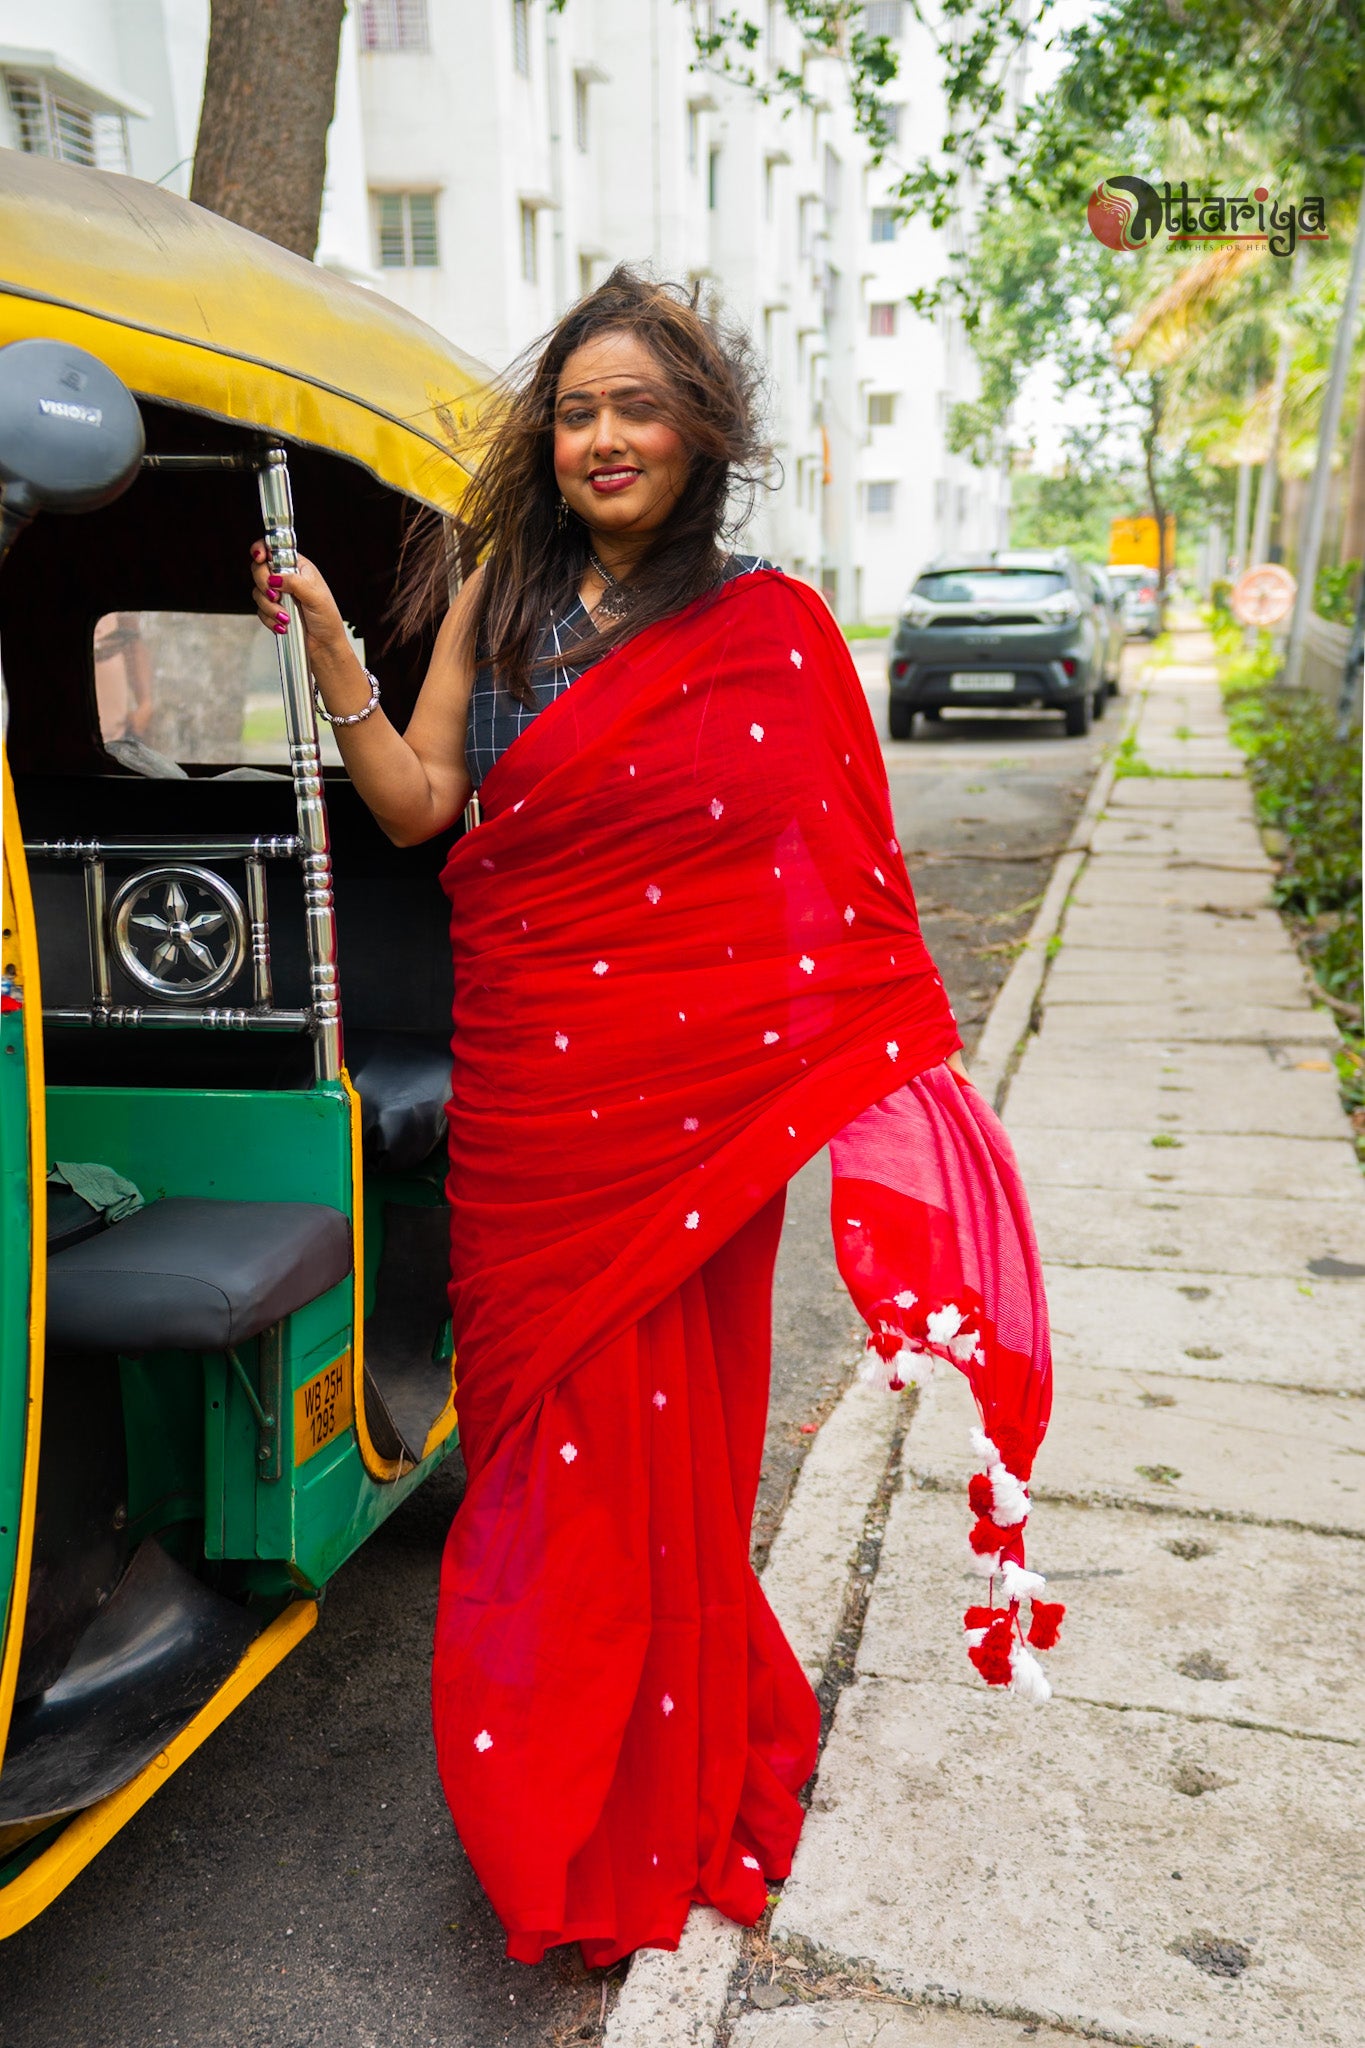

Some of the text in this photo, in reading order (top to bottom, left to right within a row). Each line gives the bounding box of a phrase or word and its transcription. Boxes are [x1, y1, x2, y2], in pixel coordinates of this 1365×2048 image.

[304, 1364, 343, 1418] WB 25H
[310, 1403, 336, 1447] 1293
